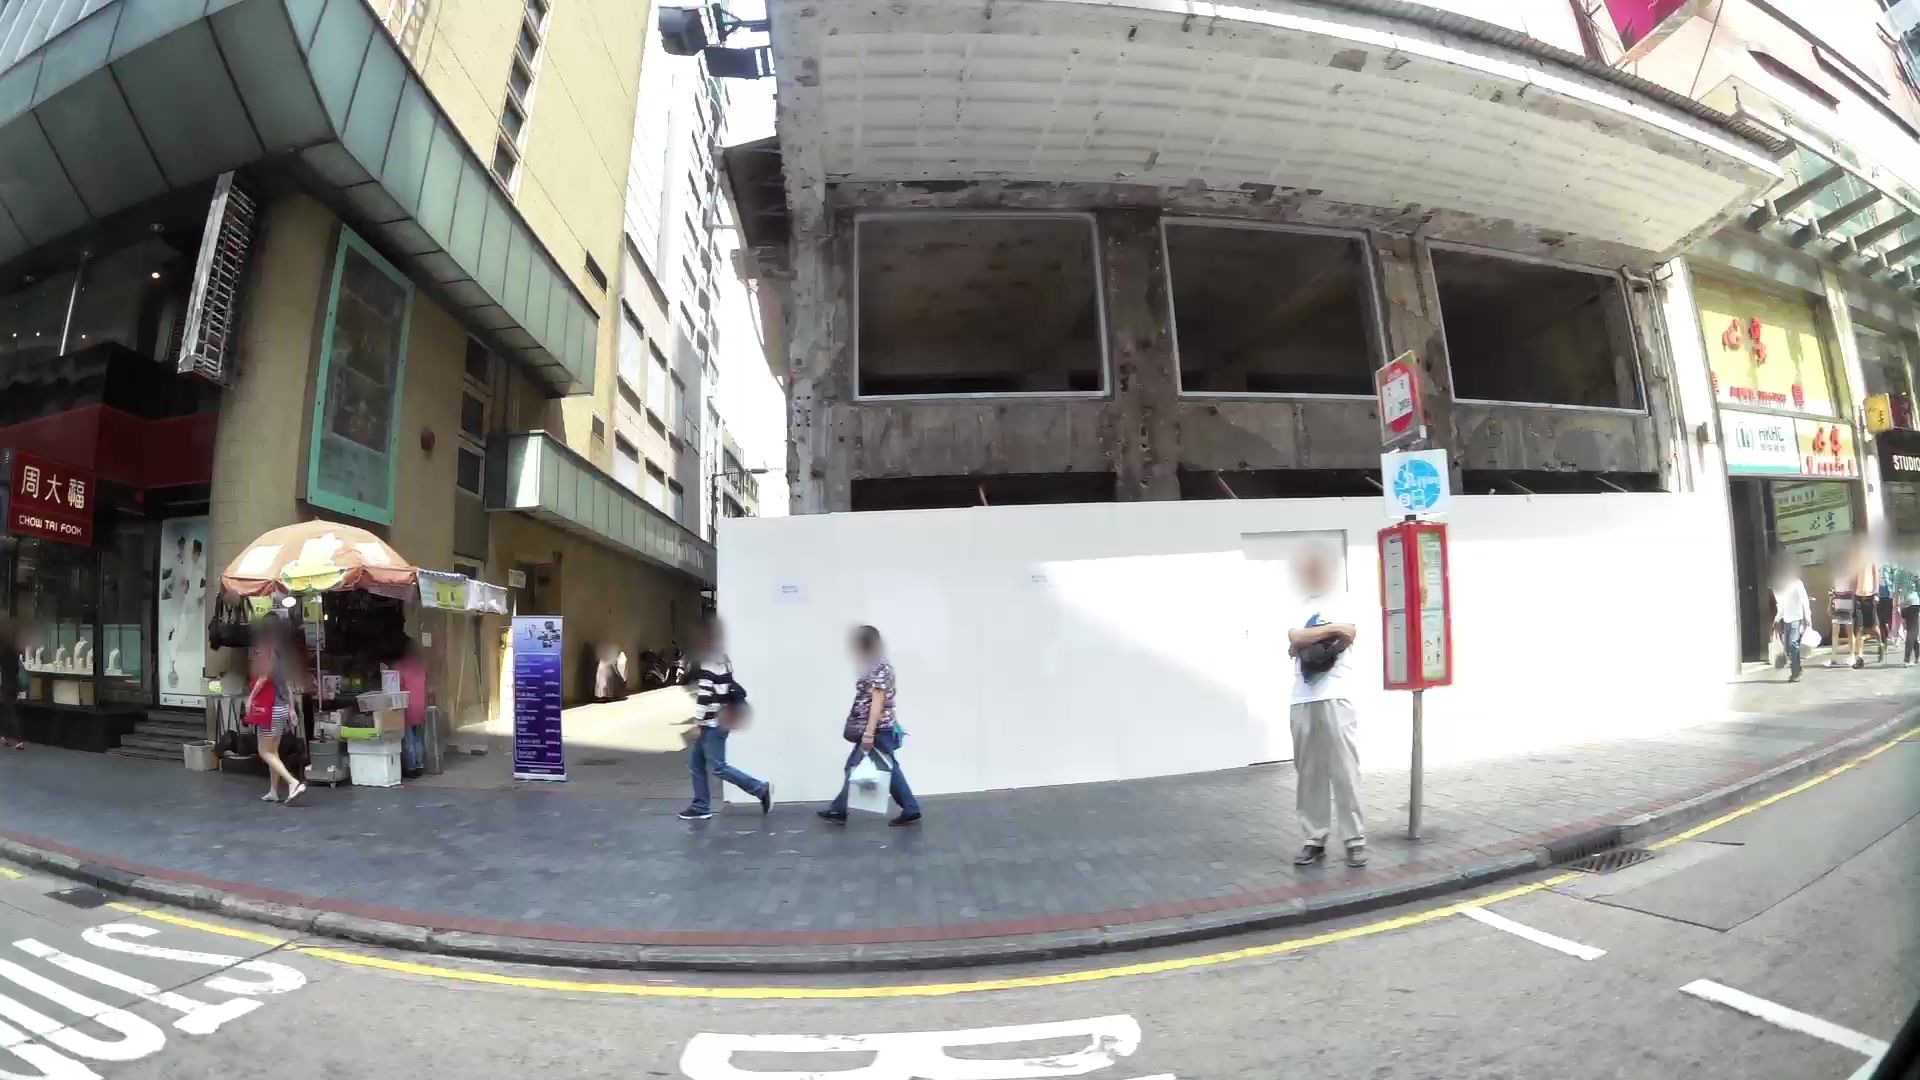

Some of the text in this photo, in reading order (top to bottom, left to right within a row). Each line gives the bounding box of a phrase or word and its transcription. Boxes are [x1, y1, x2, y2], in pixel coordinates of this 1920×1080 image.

[21, 465, 84, 508] 周大福
[18, 514, 82, 536] CHOW TAI FOOK
